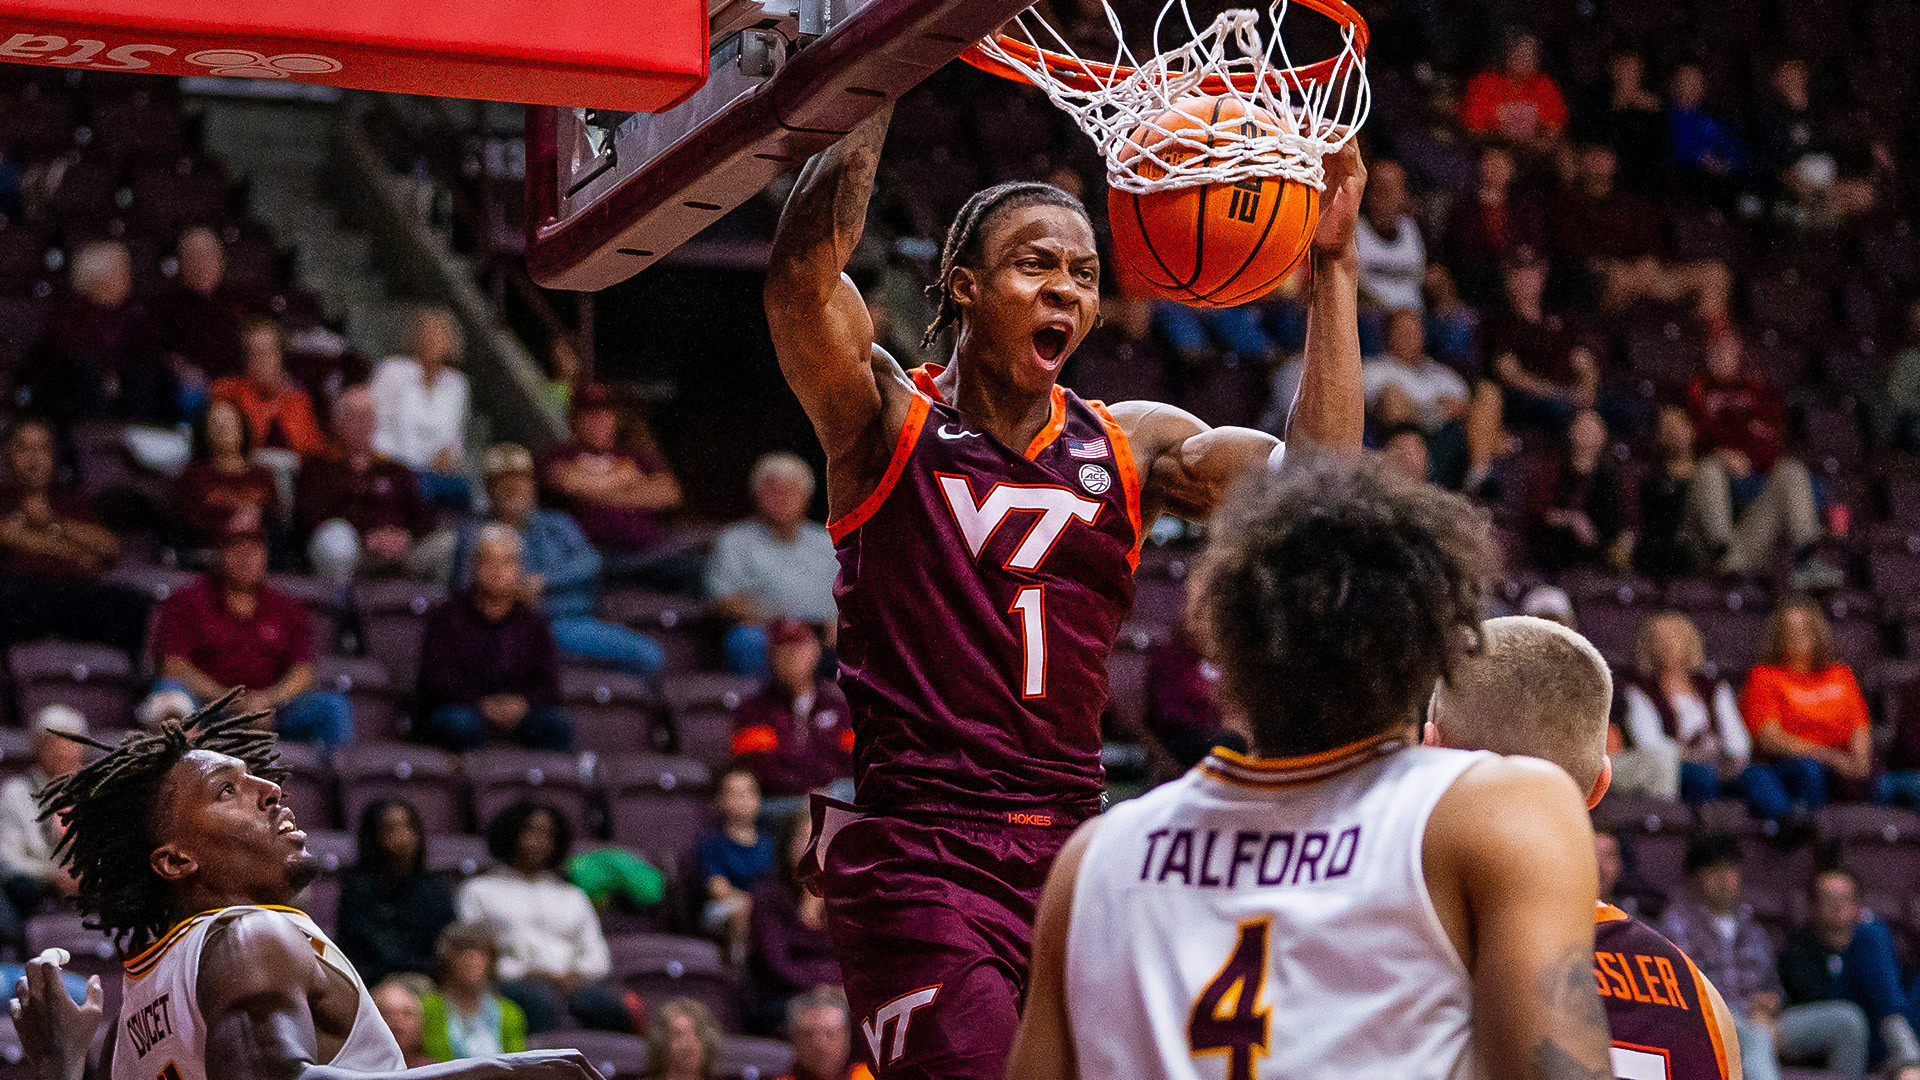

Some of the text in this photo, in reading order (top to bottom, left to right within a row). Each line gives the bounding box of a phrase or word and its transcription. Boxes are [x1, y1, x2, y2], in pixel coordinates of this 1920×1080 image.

[934, 471, 1105, 573] VT
[1008, 584, 1047, 699] 1
[1008, 813, 1051, 826] HOKIES
[1140, 825, 1361, 888] TALFORD
[861, 982, 943, 1073] VT
[1186, 911, 1276, 1080] 4
